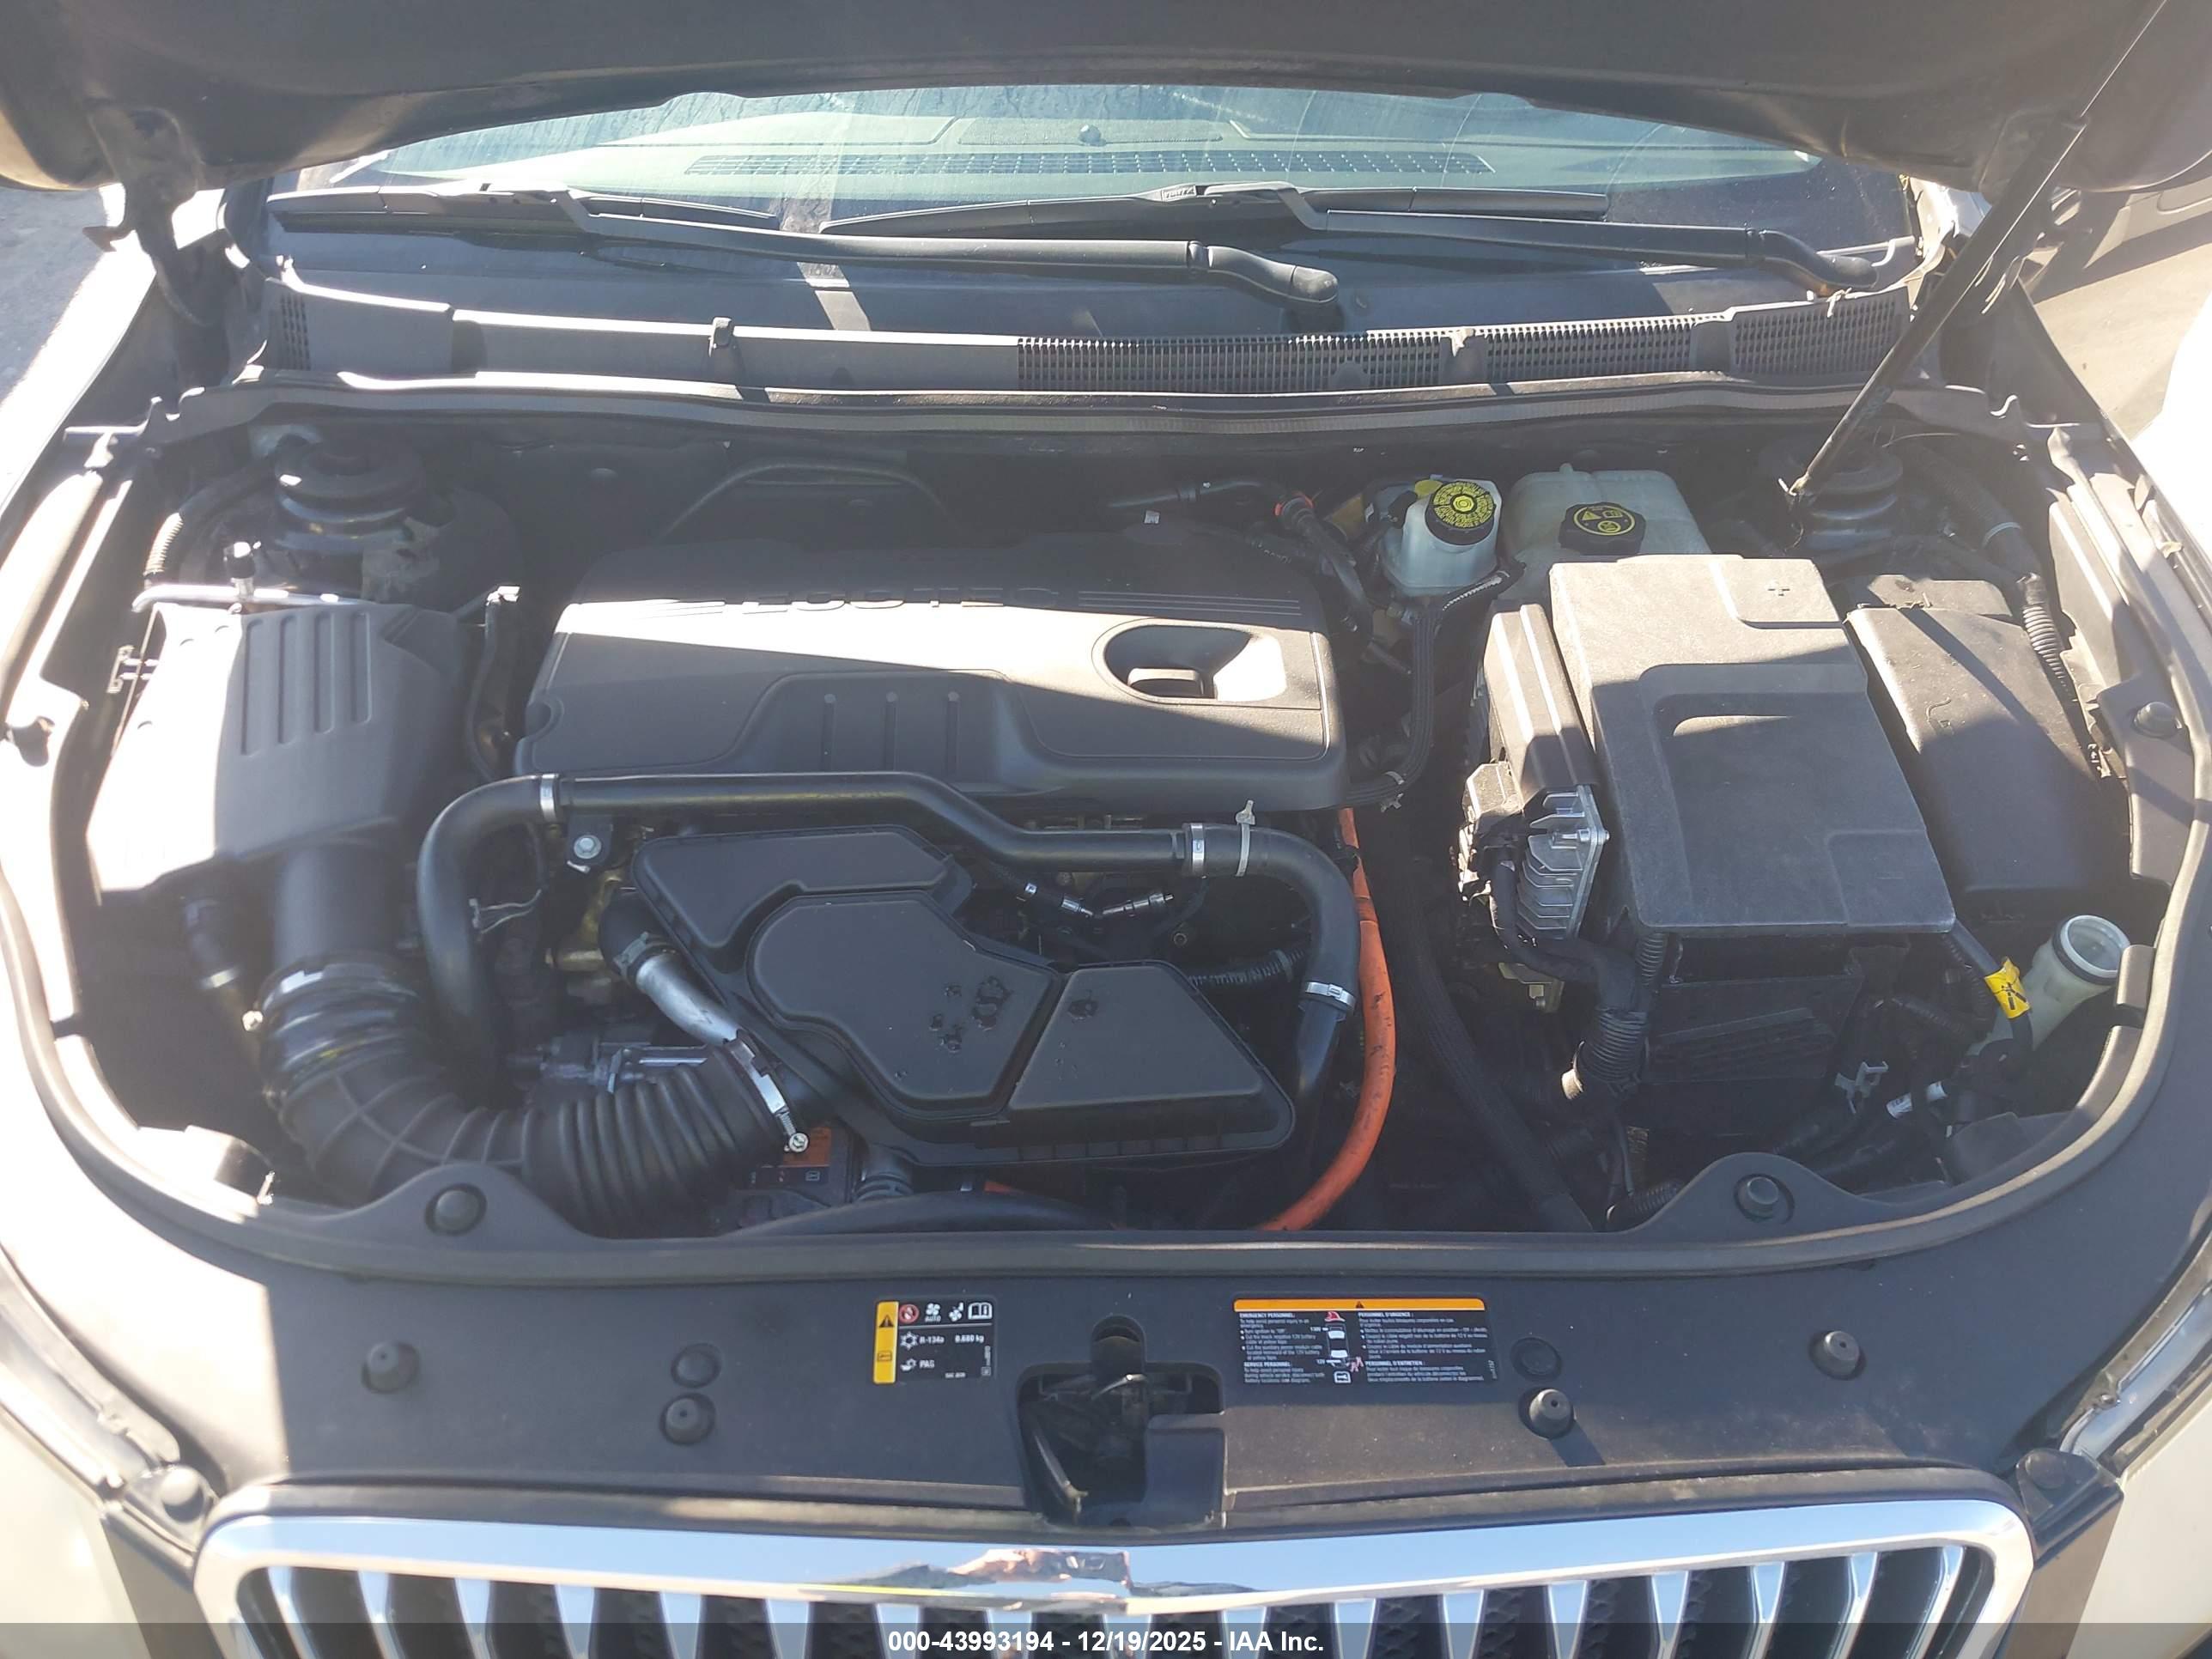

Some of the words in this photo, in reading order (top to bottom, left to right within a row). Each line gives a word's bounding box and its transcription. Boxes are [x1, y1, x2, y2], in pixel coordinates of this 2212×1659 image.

[919, 1335, 945, 1345] R-134a
[975, 1334, 985, 1344] kg
[919, 1359, 935, 1368] PAG
